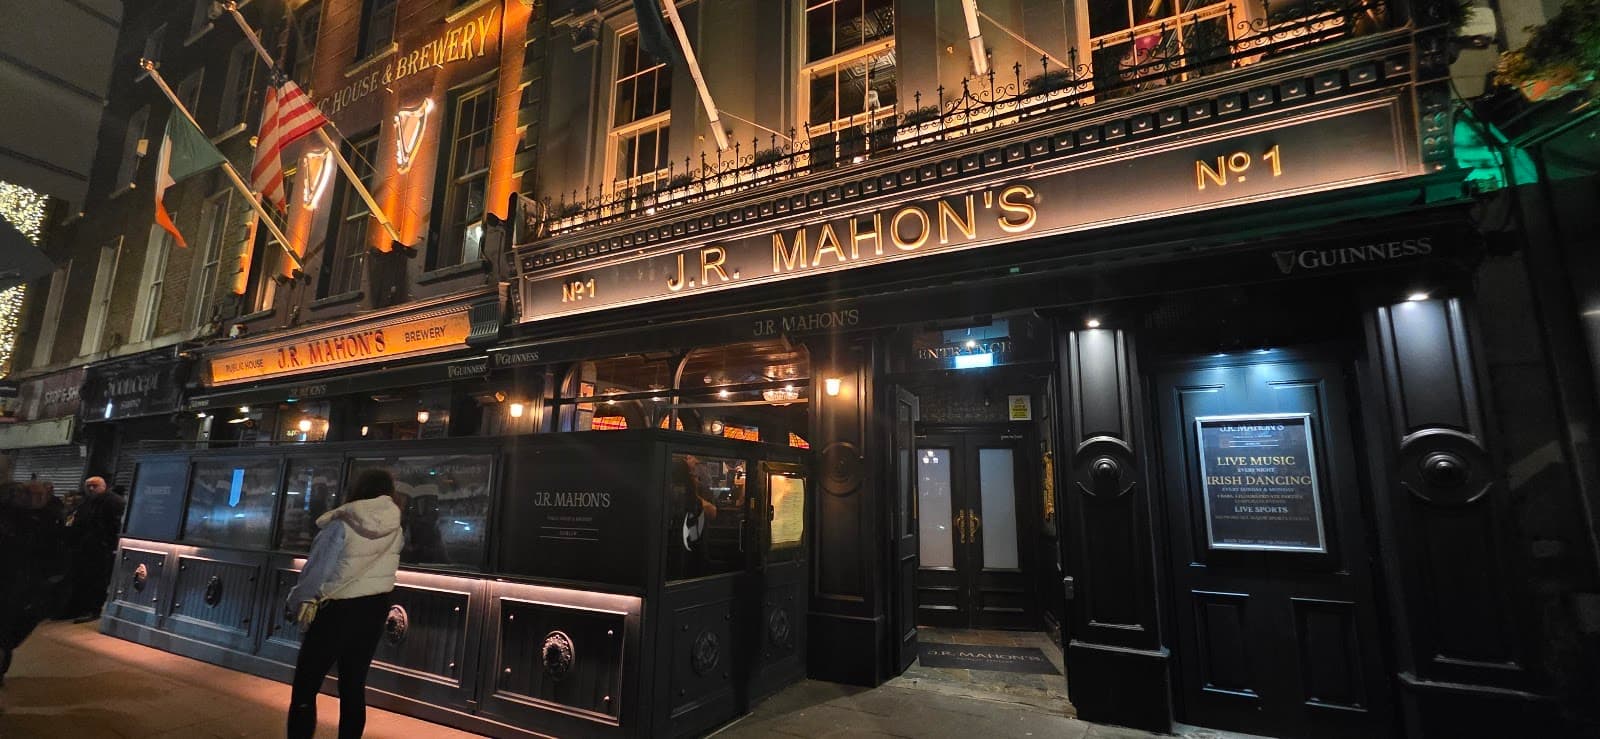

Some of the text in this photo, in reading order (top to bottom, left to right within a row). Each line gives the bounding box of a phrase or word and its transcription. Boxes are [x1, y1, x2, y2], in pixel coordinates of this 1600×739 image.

[331, 71, 379, 115] HOUSE
[381, 63, 392, 85] &
[395, 6, 497, 81] BREWERY
[667, 185, 1037, 292] J.R. MAHON'S
[1298, 236, 1433, 269] GUINNESS
[752, 309, 859, 336] J.R. MAHON'S
[404, 327, 447, 343] BREWERY
[277, 331, 386, 370] J.R. MAHON'S
[502, 352, 539, 365] GUINNESS
[225, 359, 264, 373] PUBLIC HOUSE
[453, 363, 487, 376] GUINNESS
[1217, 456, 1296, 466] LIVE MUSIC
[1207, 475, 1312, 486] IRISH DANCING
[554, 491, 611, 508] MAHON'S
[1254, 506, 1289, 514] SPORTS
